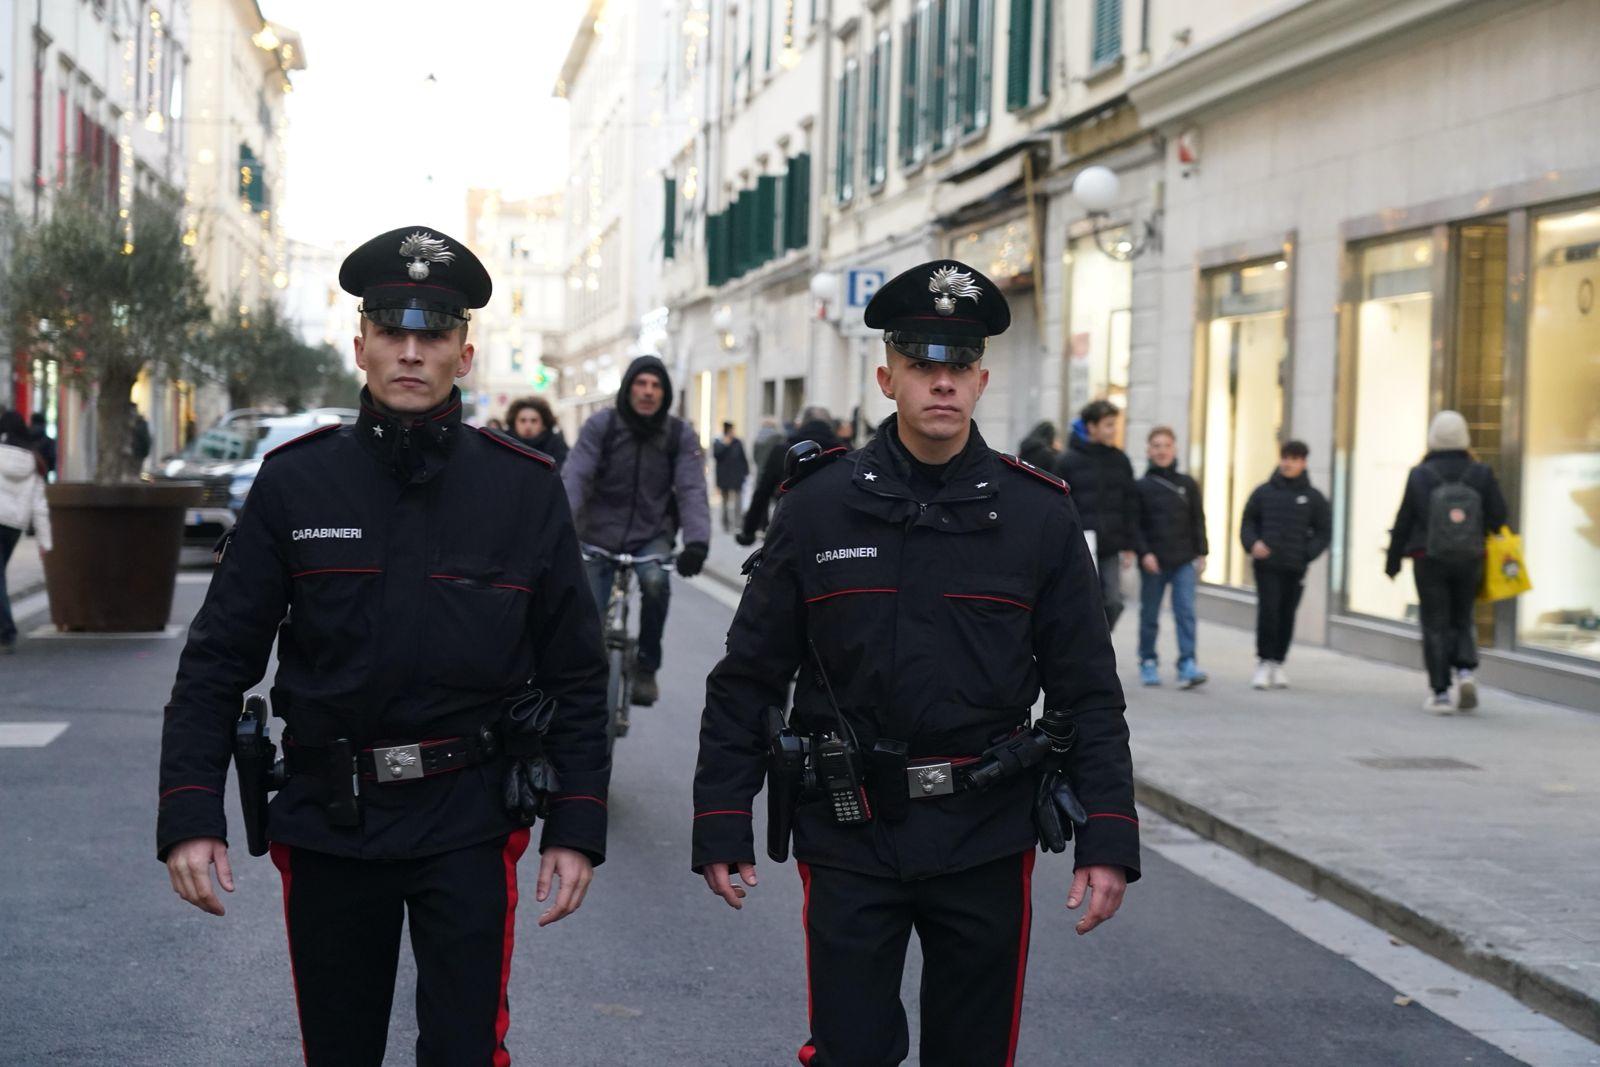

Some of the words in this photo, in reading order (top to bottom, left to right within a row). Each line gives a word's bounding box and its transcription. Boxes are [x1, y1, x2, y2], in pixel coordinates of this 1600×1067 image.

[856, 272, 882, 305] P
[292, 528, 362, 541] CARABINIERI
[815, 547, 878, 564] CARABINIERI
